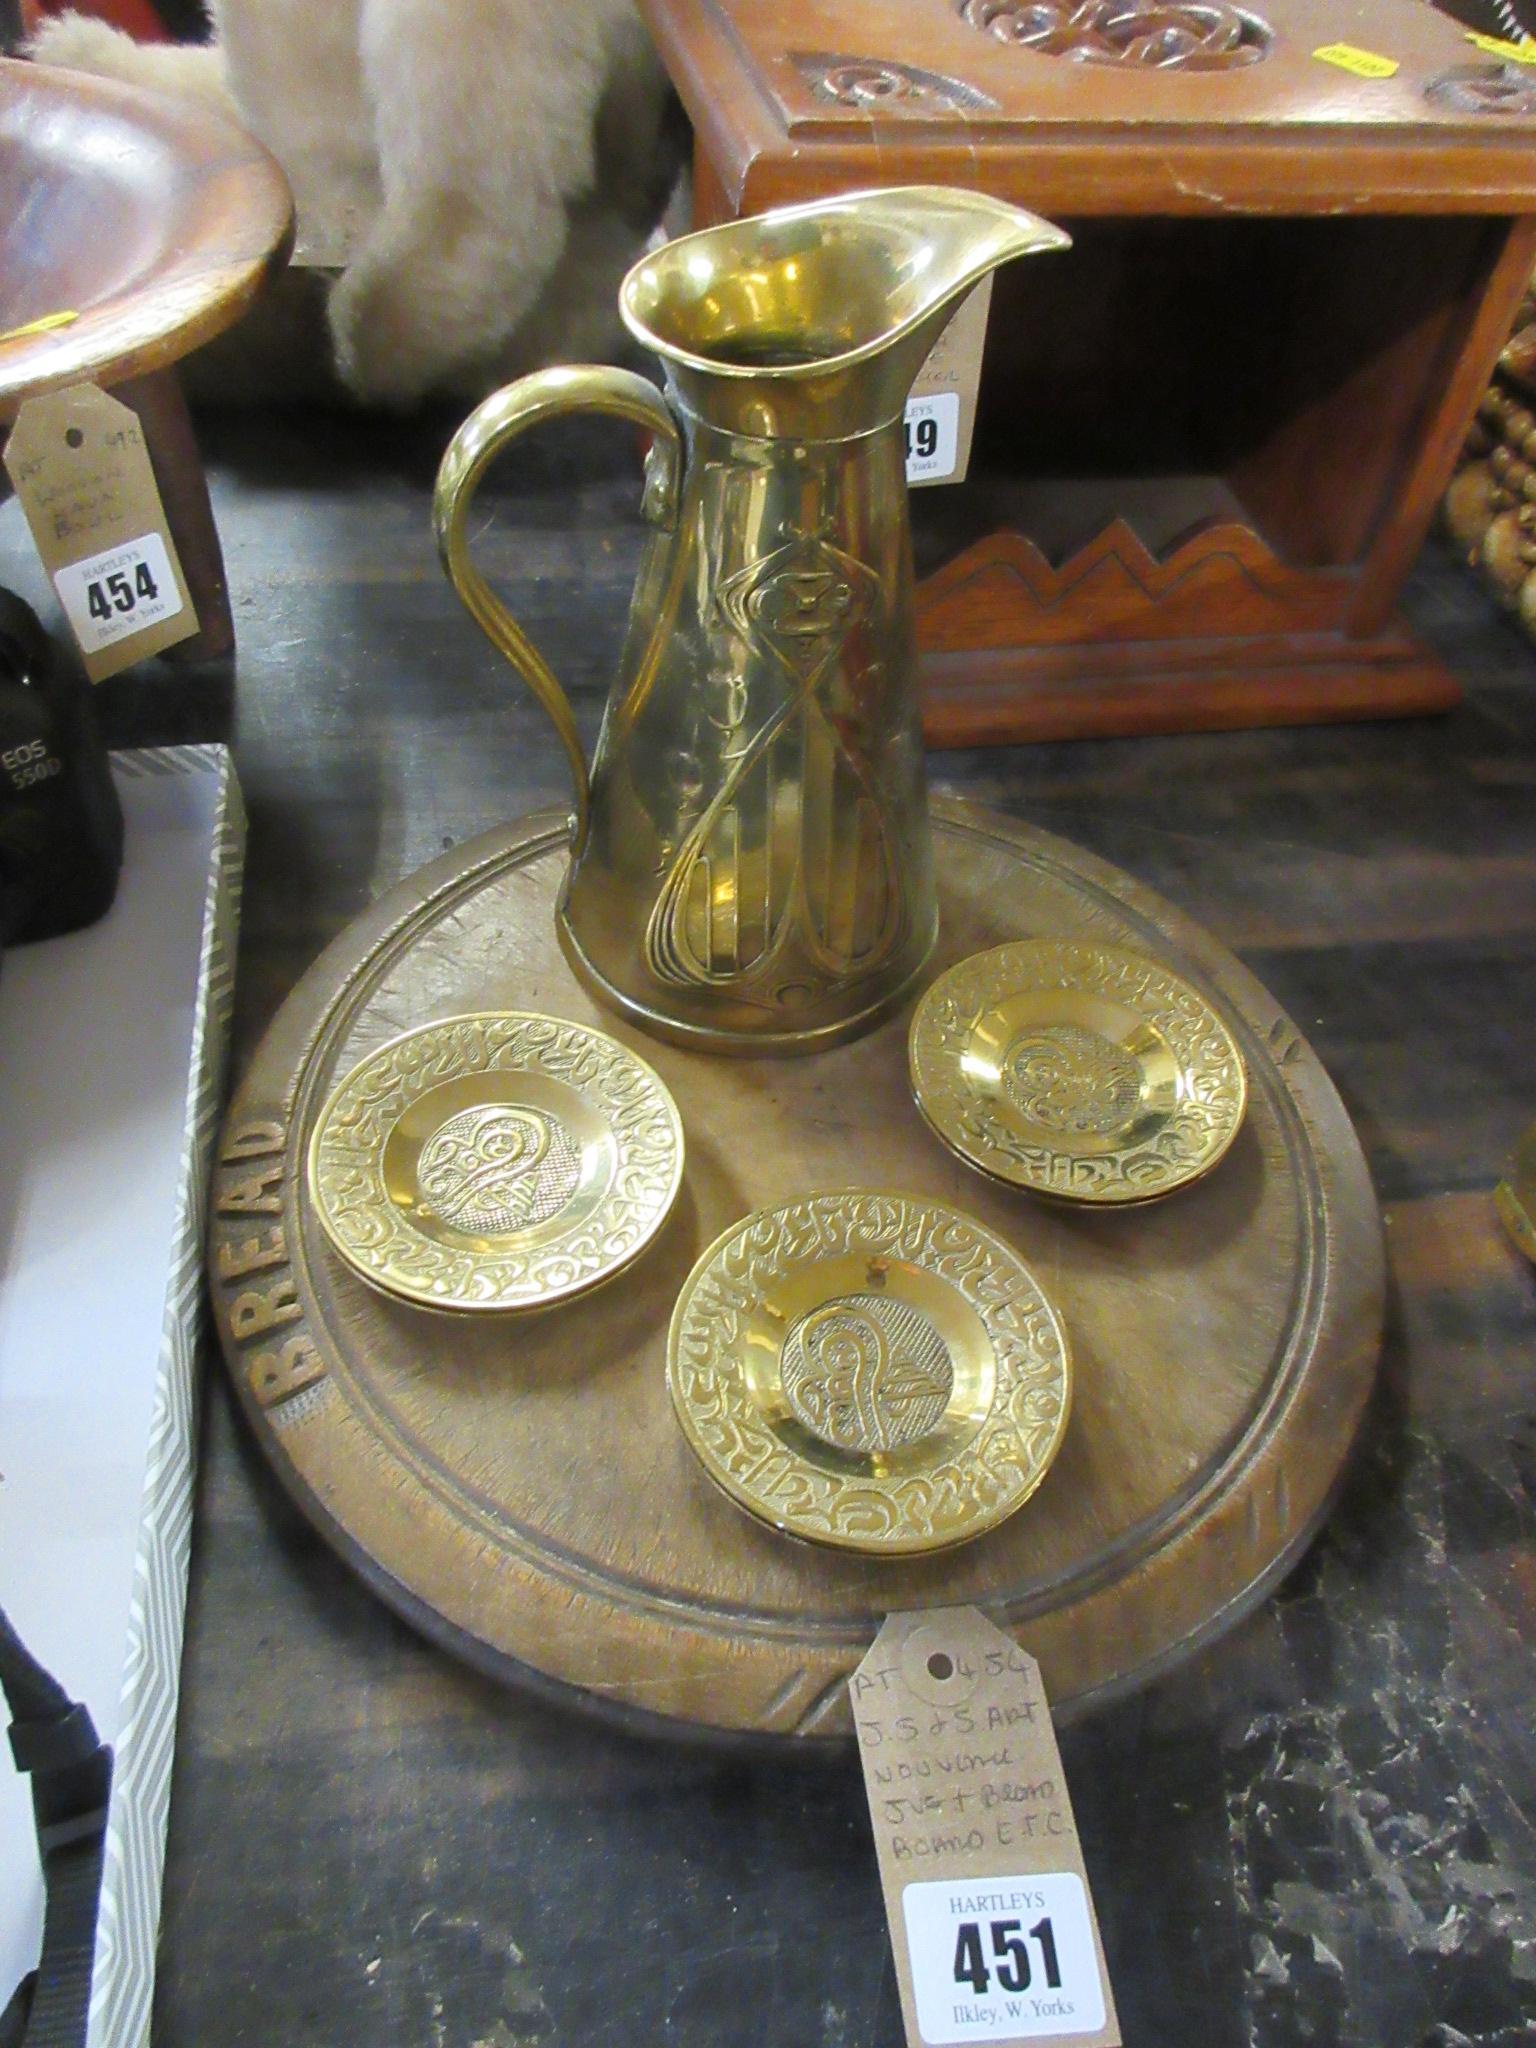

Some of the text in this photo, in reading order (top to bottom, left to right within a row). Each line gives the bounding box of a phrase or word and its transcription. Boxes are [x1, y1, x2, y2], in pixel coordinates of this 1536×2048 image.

[87, 561, 158, 620] 454
[1, 739, 47, 770] EOS
[217, 1119, 327, 1407] BREAD
[854, 1667, 899, 1699] AT
[950, 1891, 1046, 1914] HARTLEYS
[953, 1916, 1063, 1995] 451
[1030, 1996, 1076, 2019] Yorks
